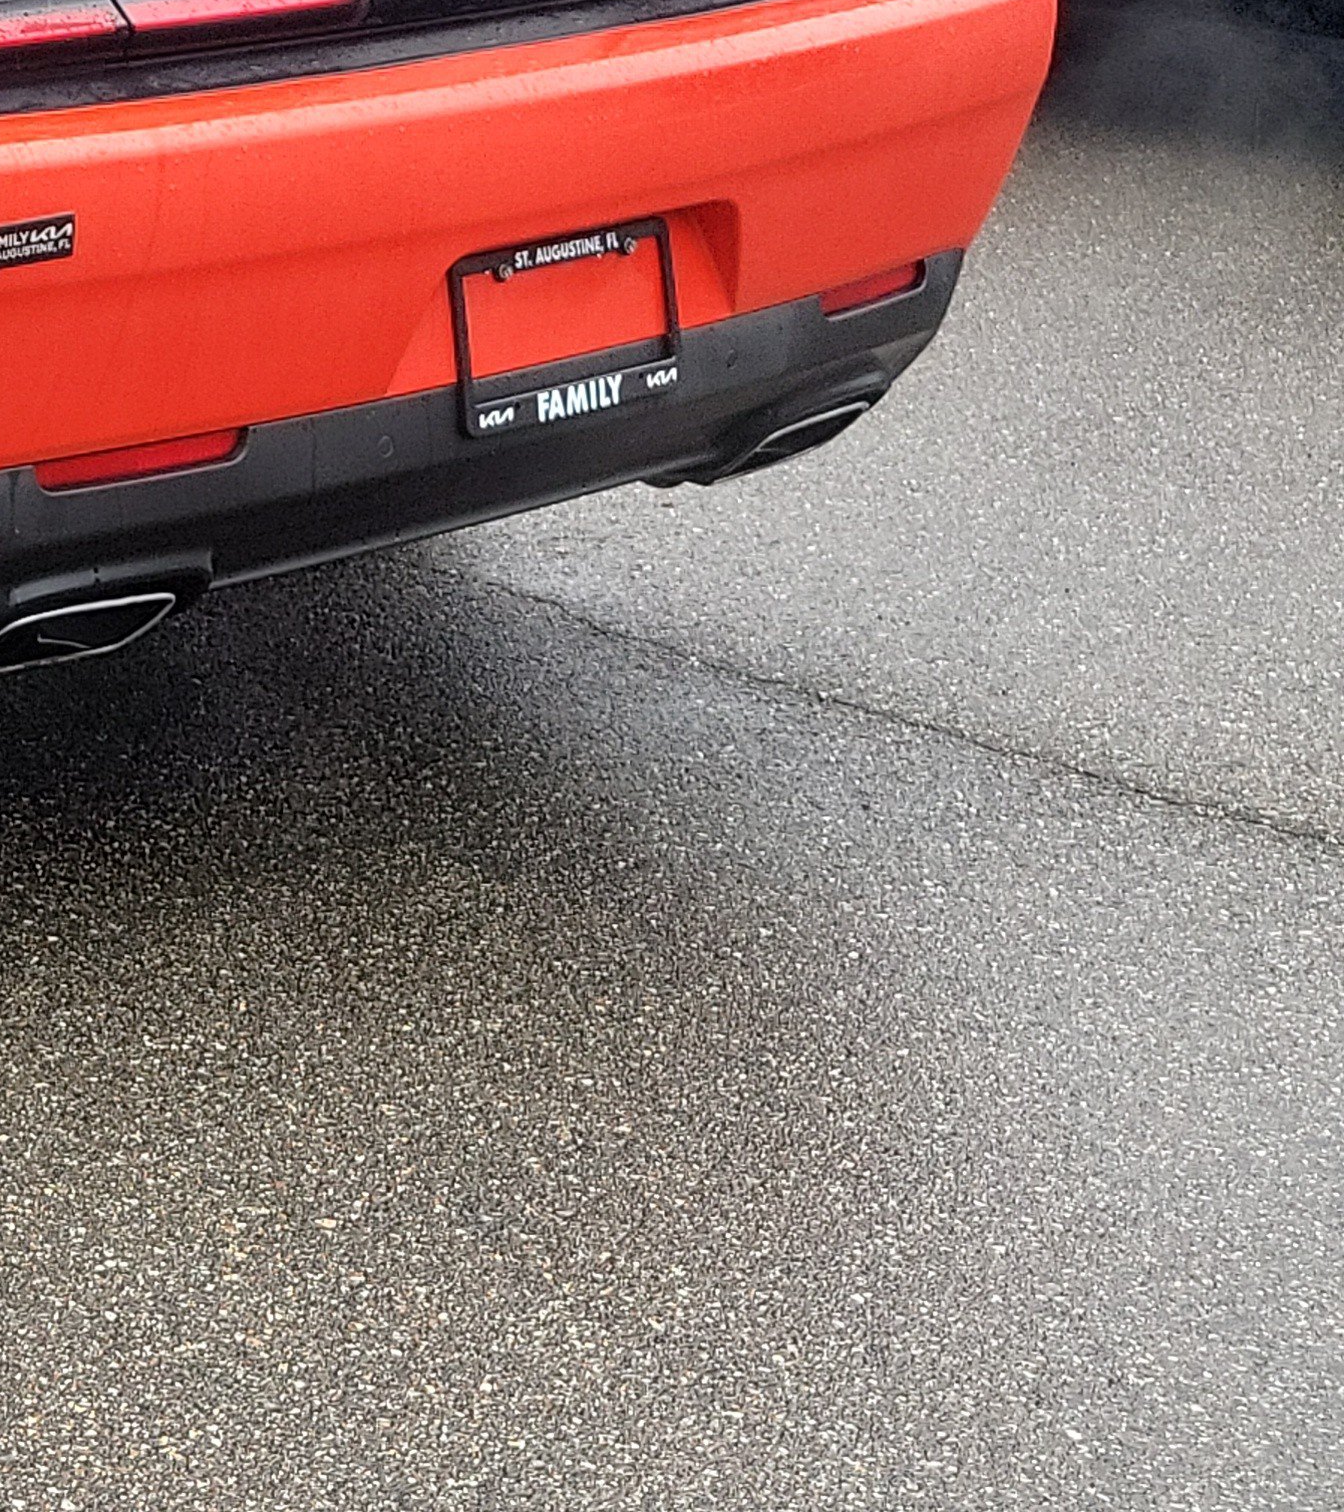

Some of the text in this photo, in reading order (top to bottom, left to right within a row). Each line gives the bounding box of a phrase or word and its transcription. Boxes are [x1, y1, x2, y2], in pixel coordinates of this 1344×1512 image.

[58, 238, 71, 250] FL
[514, 232, 619, 270] ST. AUGUSTINE, FL
[536, 373, 623, 423] FAMILY
